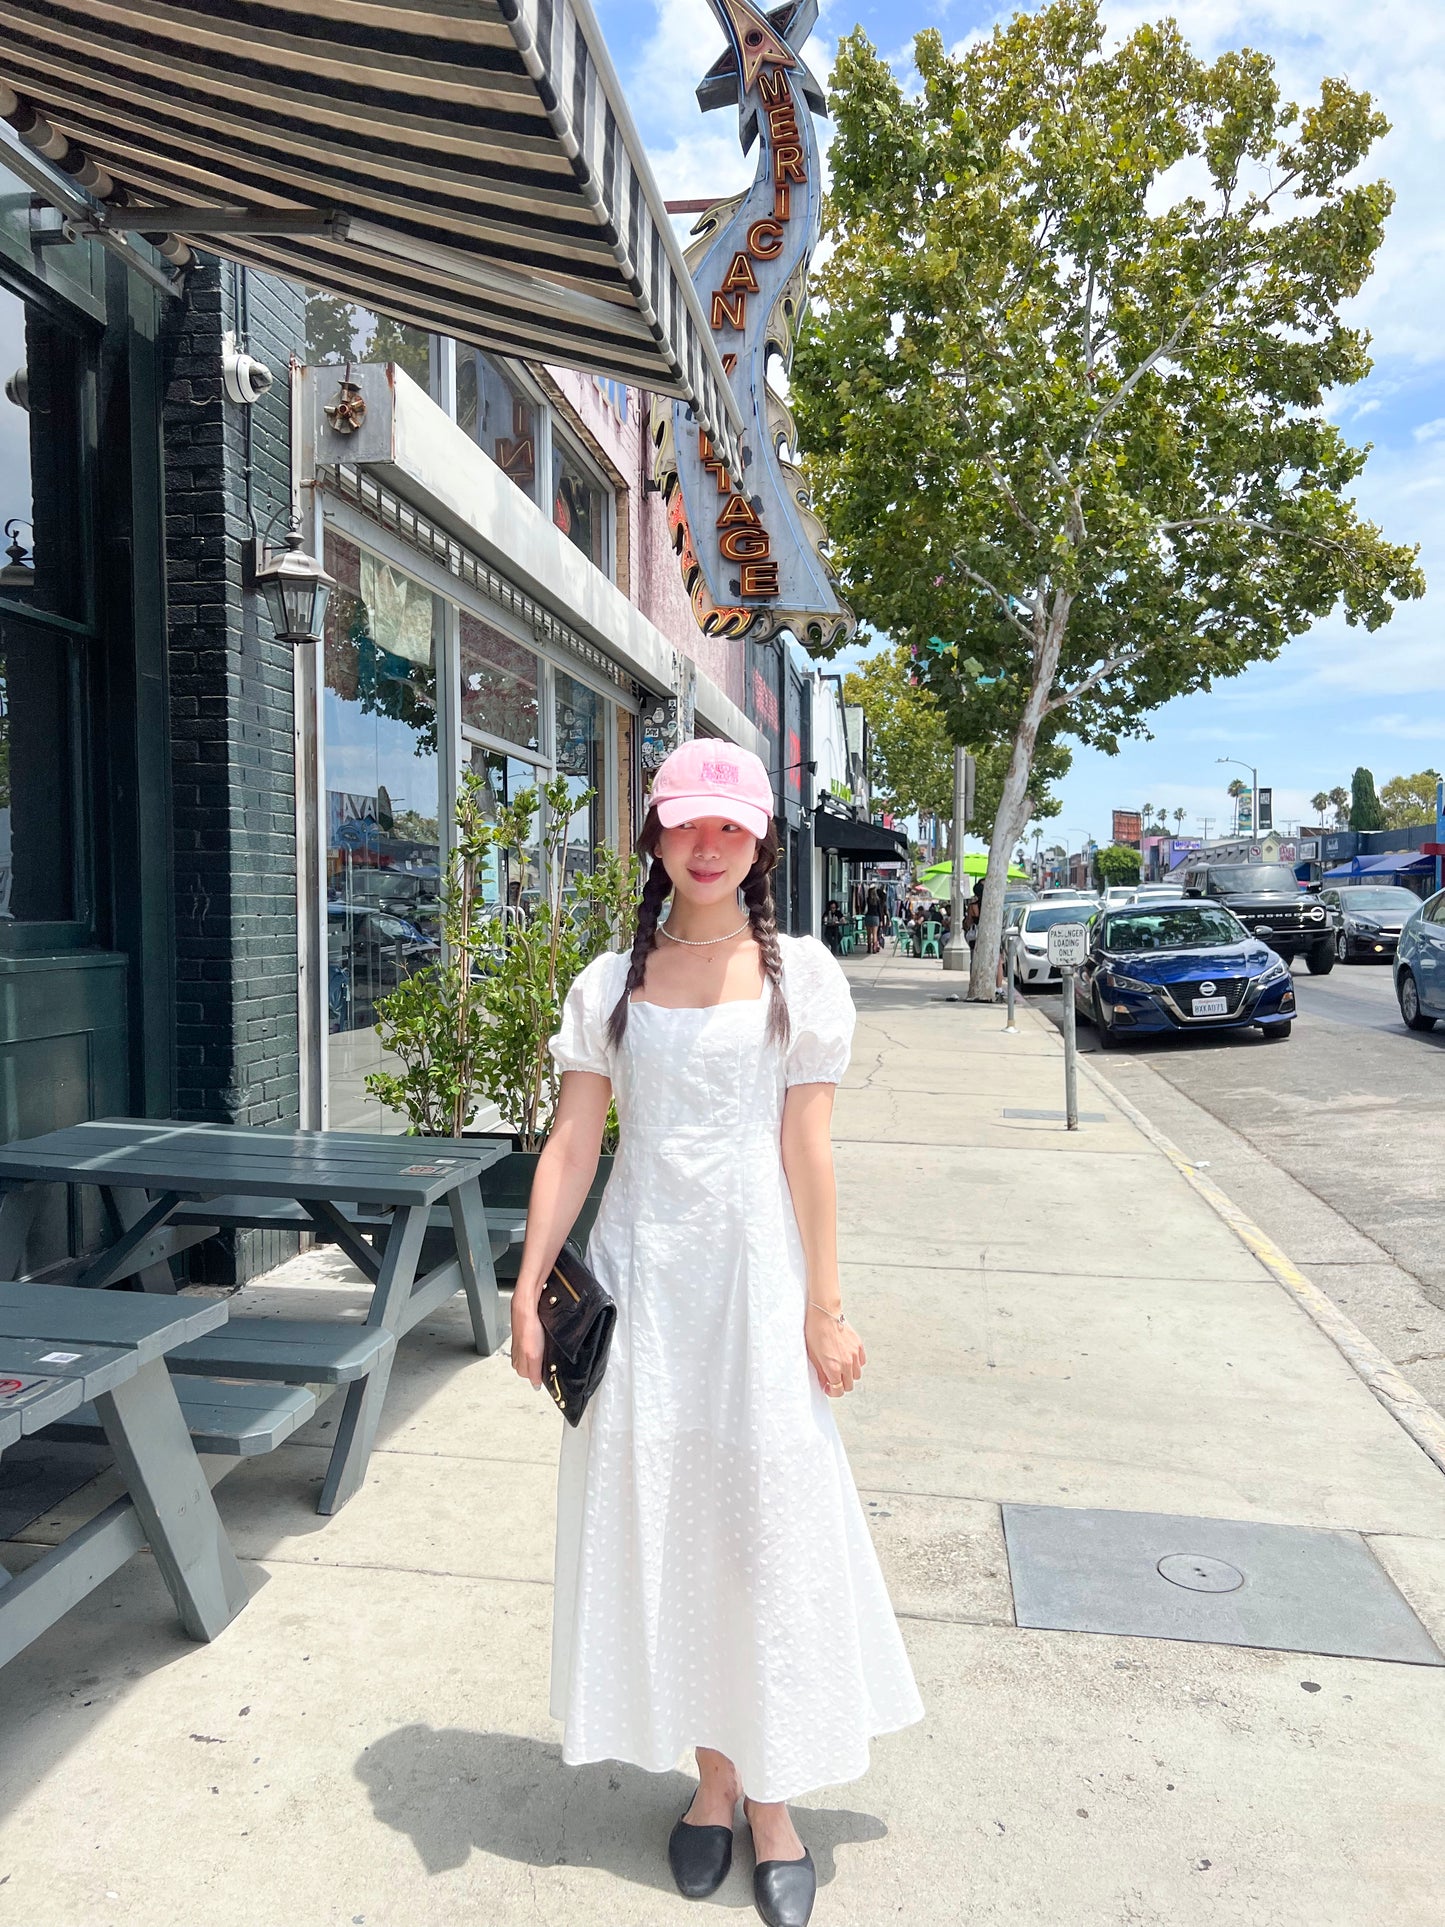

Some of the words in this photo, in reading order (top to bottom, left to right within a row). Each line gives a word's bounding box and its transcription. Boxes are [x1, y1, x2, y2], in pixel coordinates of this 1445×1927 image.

[698, 353, 780, 597] TAGE
[1050, 930, 1084, 938] PANGER
[1053, 939, 1080, 947] LOADING
[1058, 949, 1074, 957] ONLY
